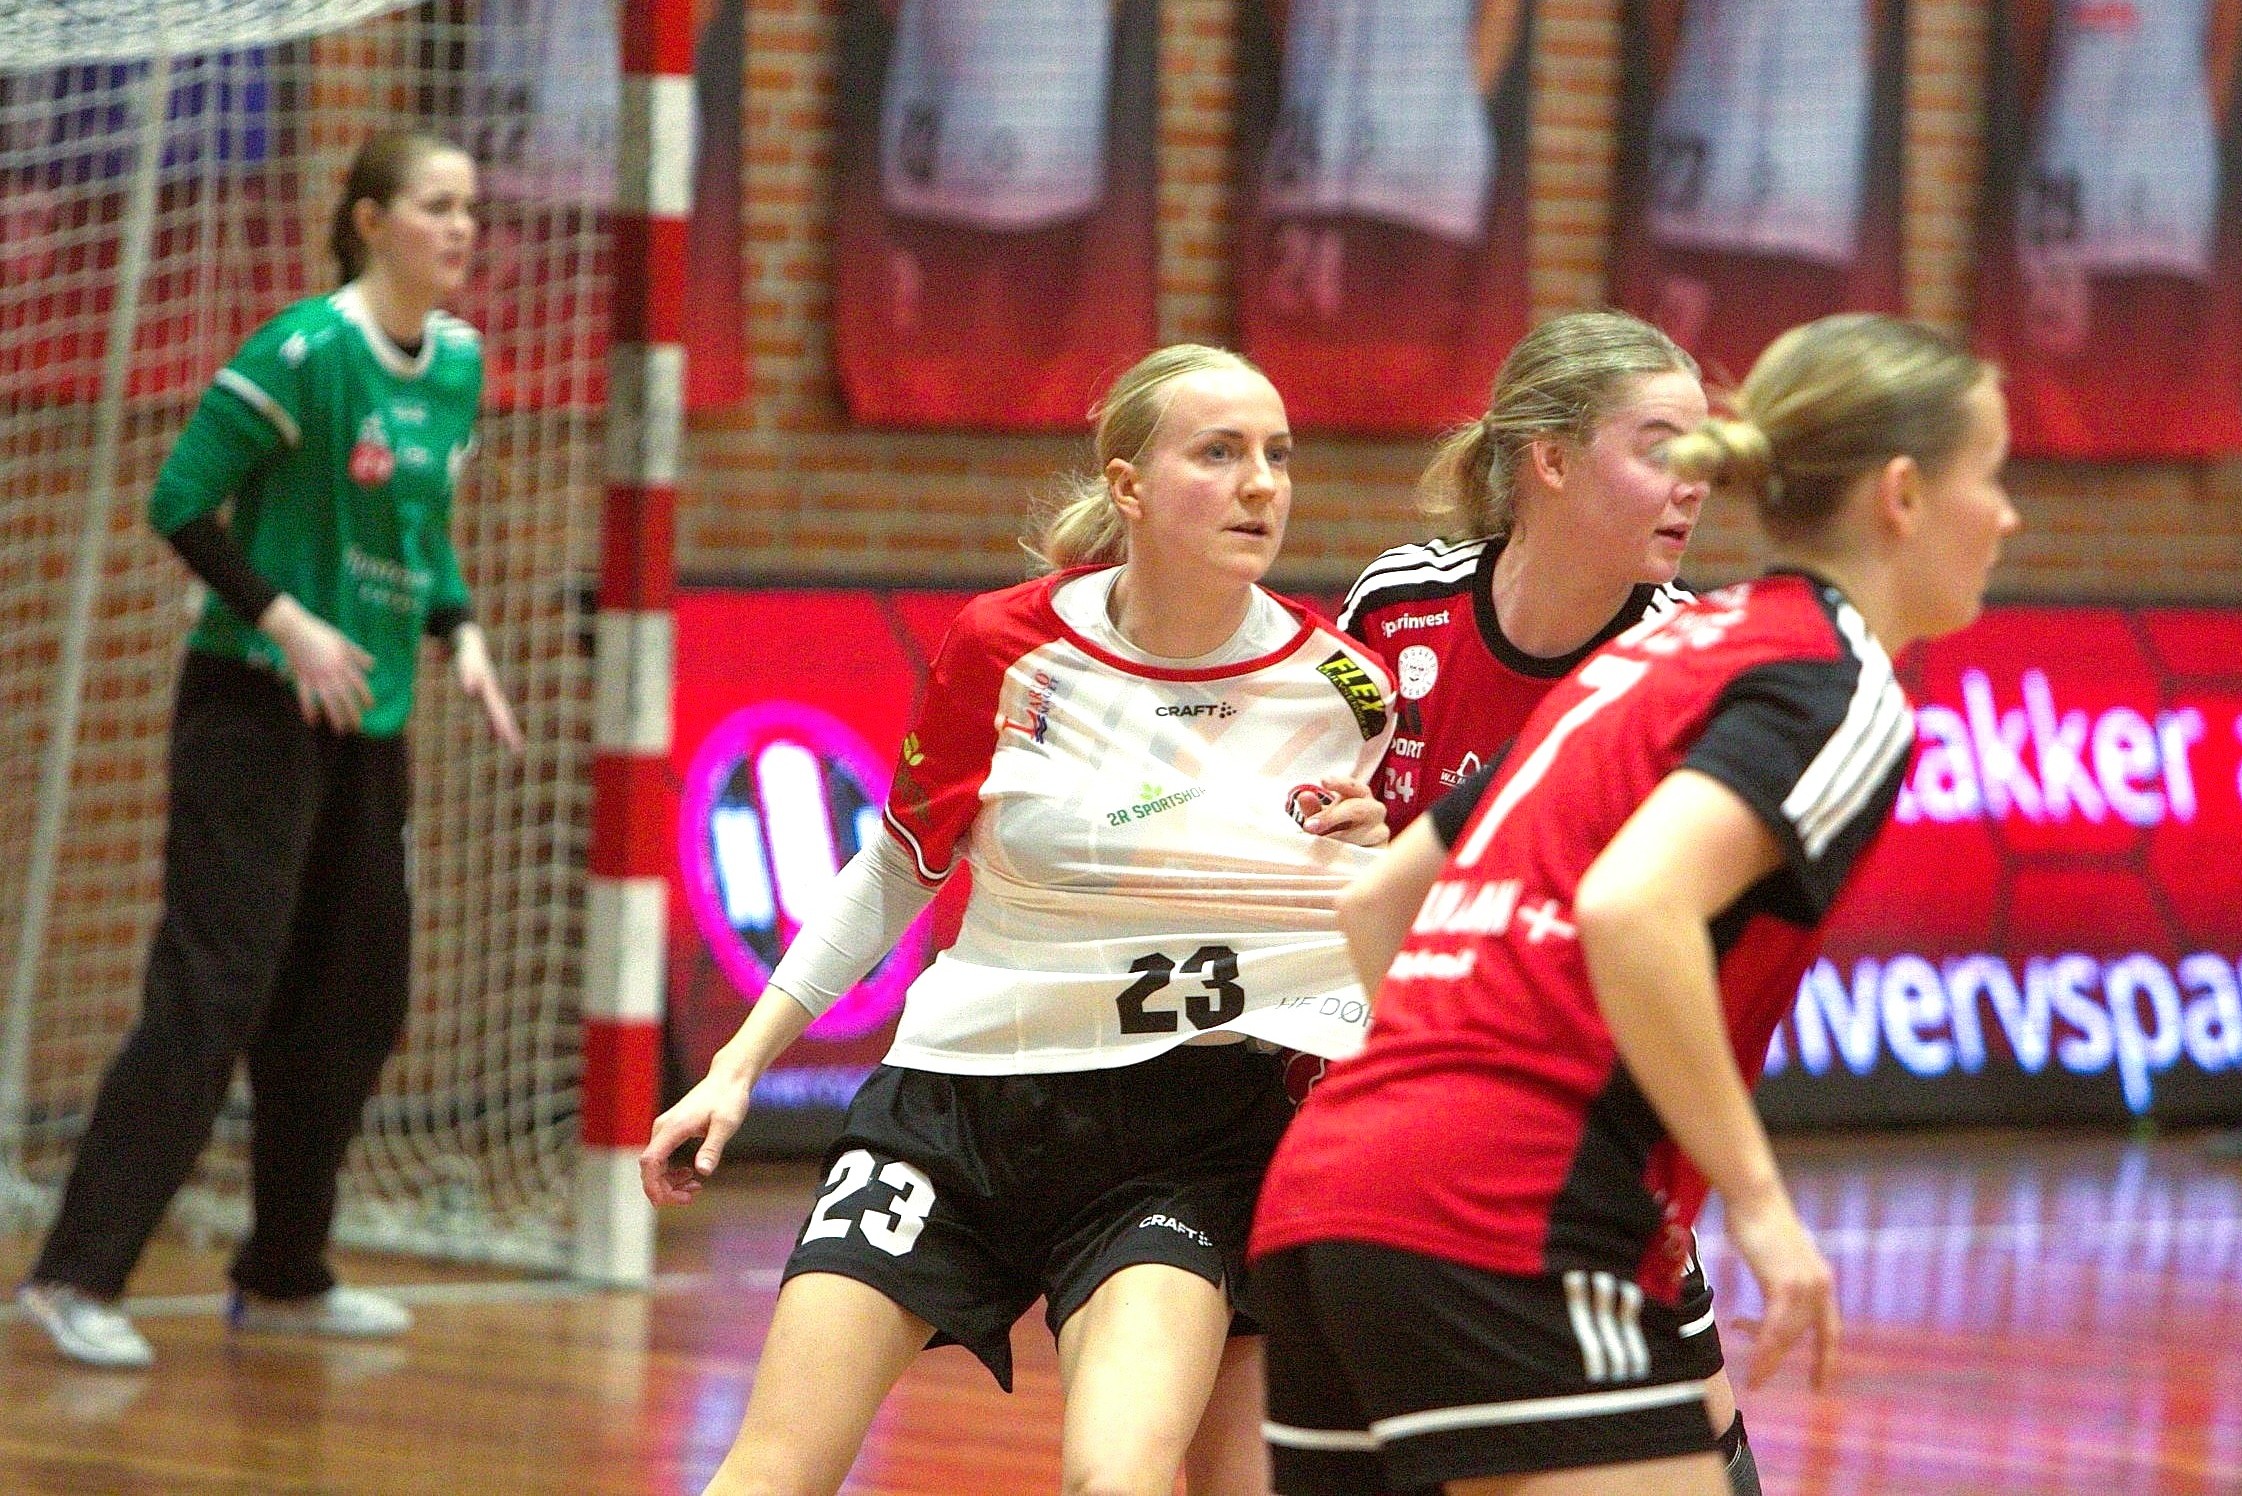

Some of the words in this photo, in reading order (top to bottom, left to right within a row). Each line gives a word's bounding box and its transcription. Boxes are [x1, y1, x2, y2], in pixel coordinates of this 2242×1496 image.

[1318, 657, 1386, 712] FLEX
[1155, 705, 1218, 717] CRAFT
[1895, 667, 2205, 823] akker
[1384, 767, 1414, 803] 24
[1106, 809, 1132, 827] 2R
[1115, 946, 1246, 1035] 23
[801, 1148, 938, 1257] 23
[1138, 1214, 1198, 1239] CRAFT
